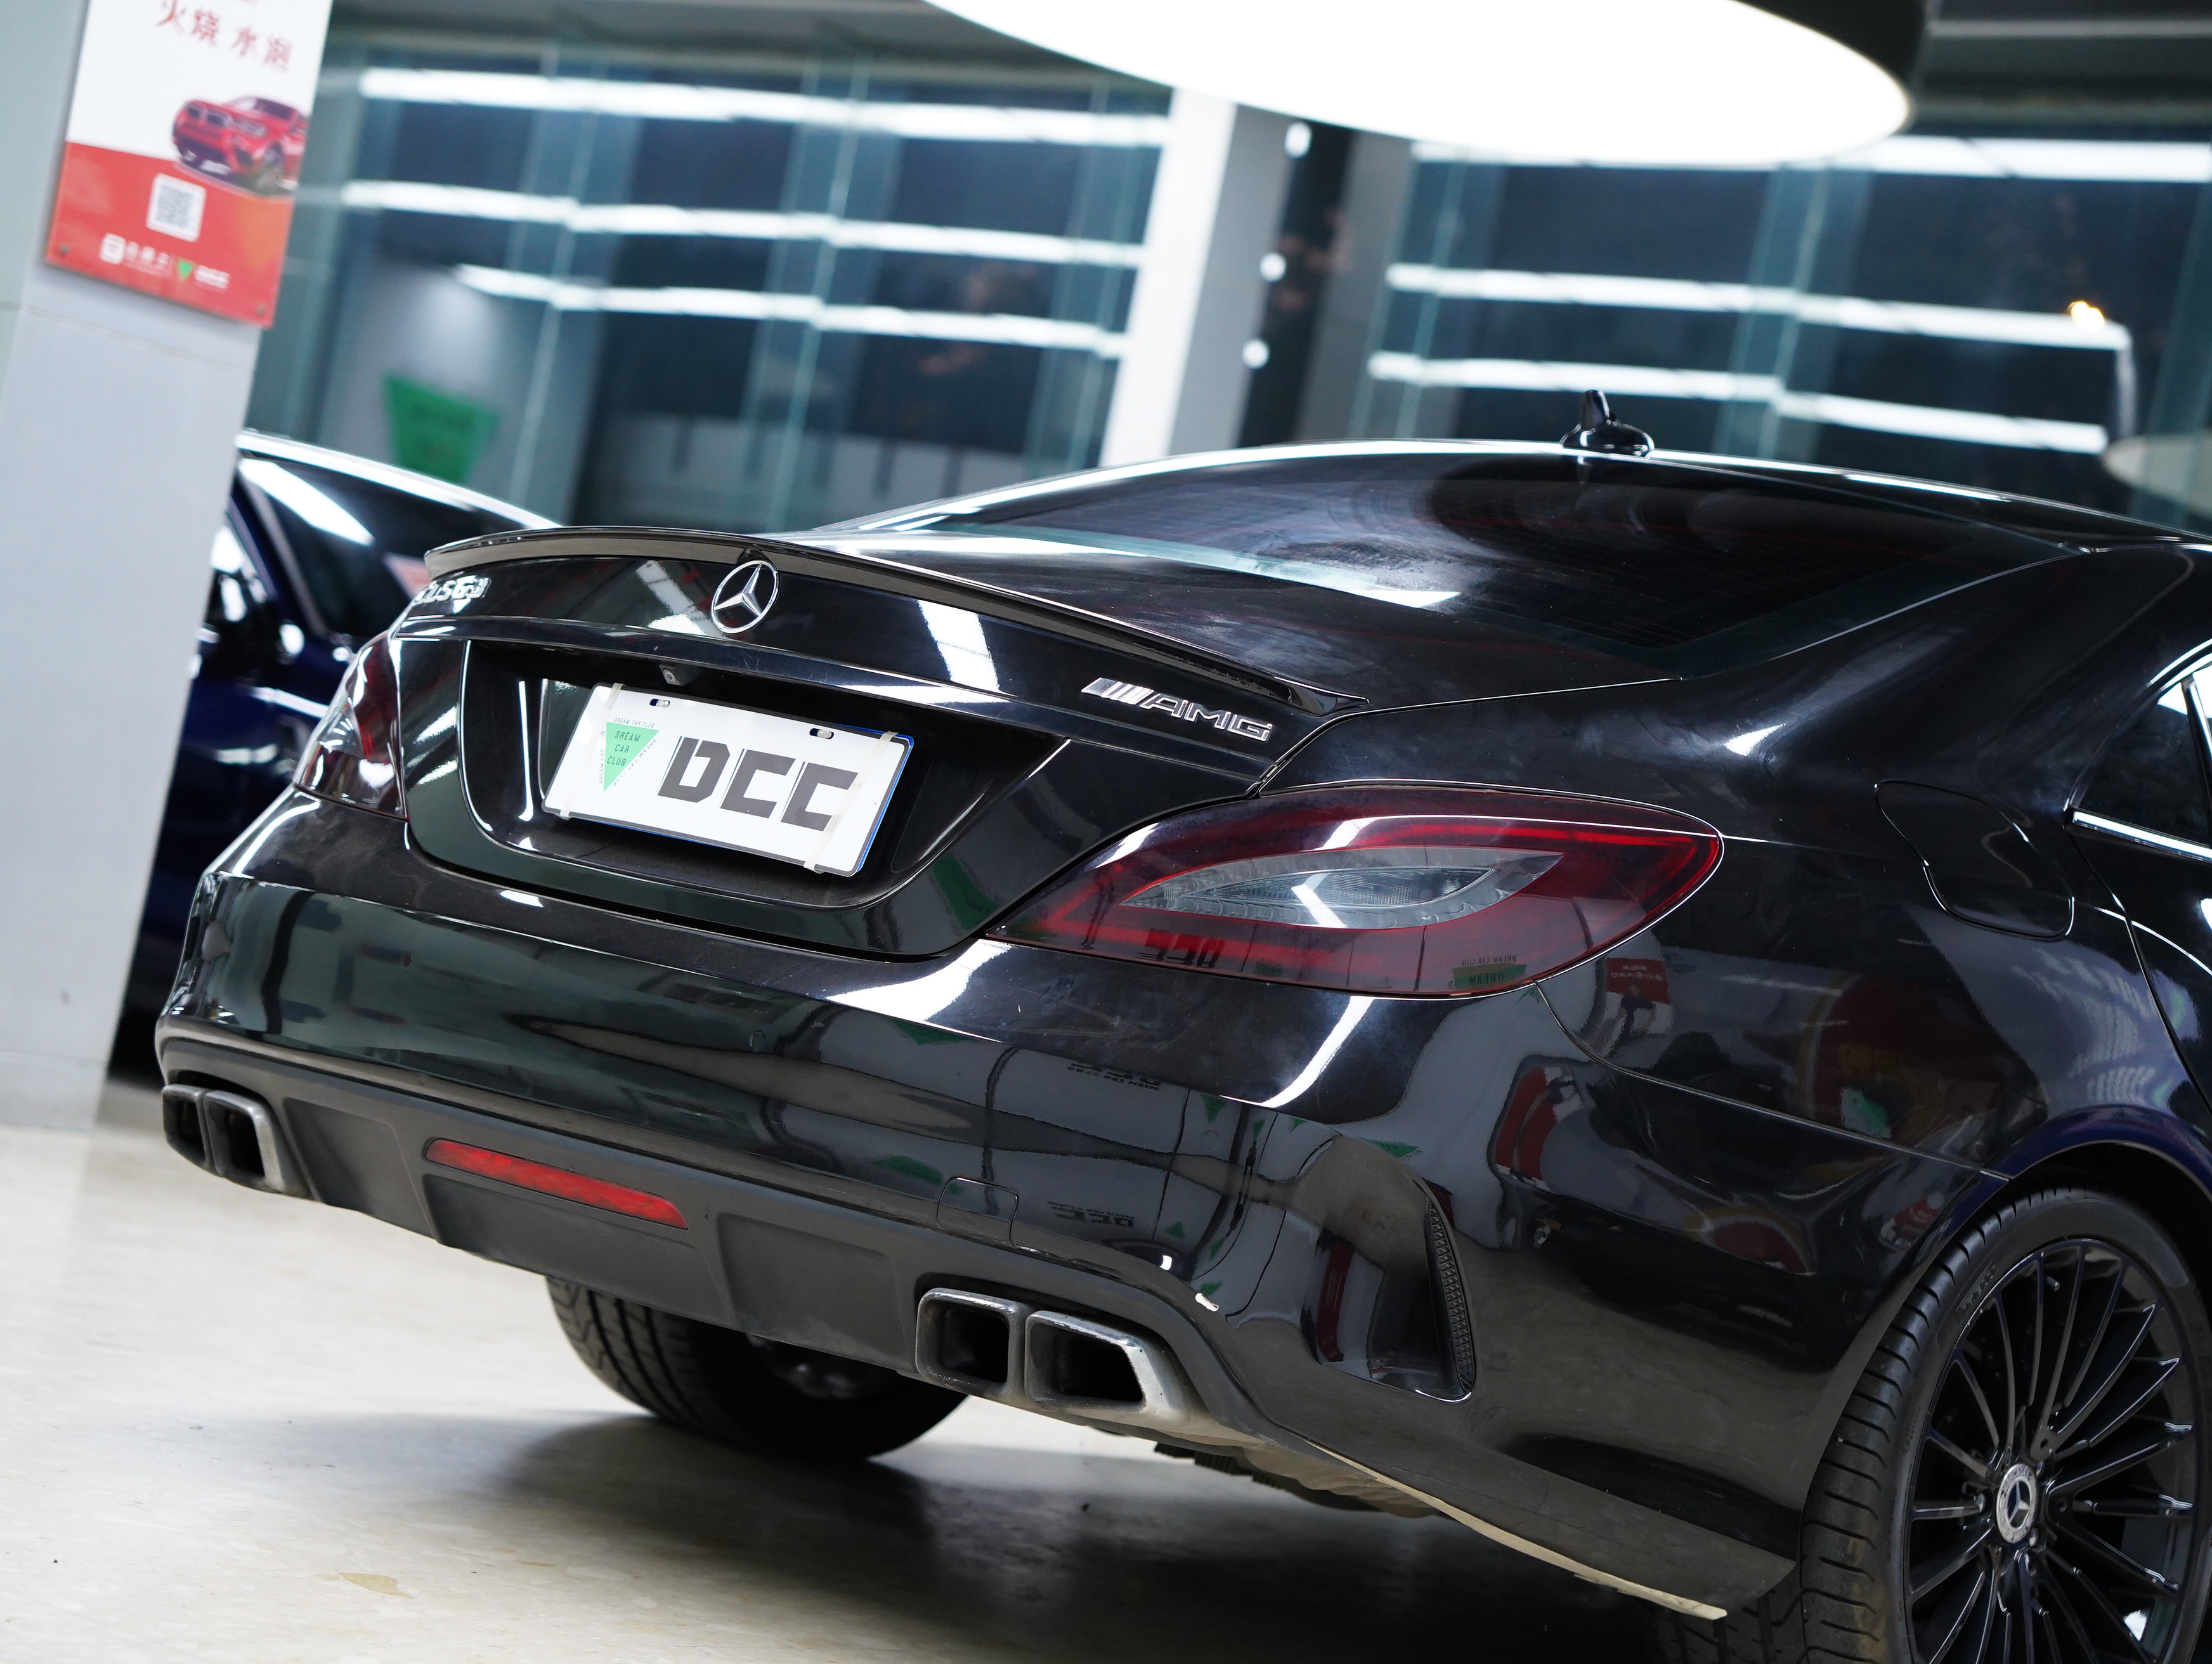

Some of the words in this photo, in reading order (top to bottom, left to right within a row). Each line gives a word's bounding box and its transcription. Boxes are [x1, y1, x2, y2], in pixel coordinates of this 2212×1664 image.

[1139, 692, 1272, 741] AMG
[615, 731, 641, 742] DREAM
[615, 744, 630, 753] CAR
[607, 756, 627, 766] CLUB
